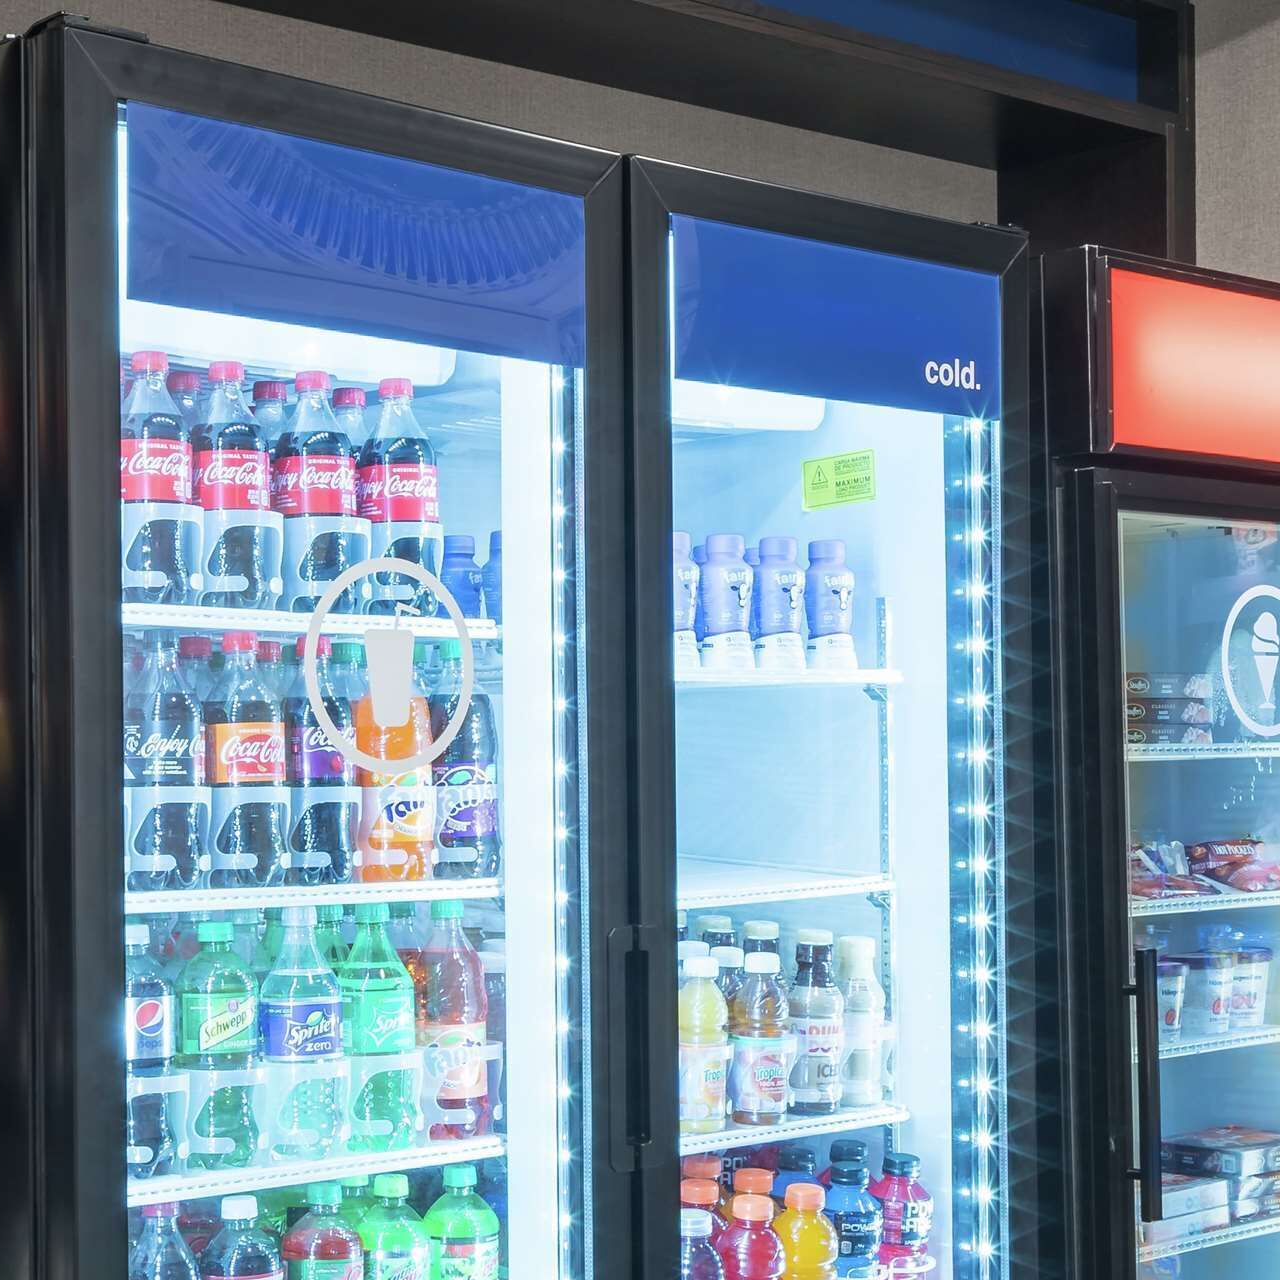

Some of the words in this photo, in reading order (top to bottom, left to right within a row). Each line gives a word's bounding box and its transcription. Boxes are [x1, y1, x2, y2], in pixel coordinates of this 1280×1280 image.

[926, 359, 981, 390] cold.
[835, 475, 871, 487] MAXIMUM
[141, 732, 190, 758] Enjoy
